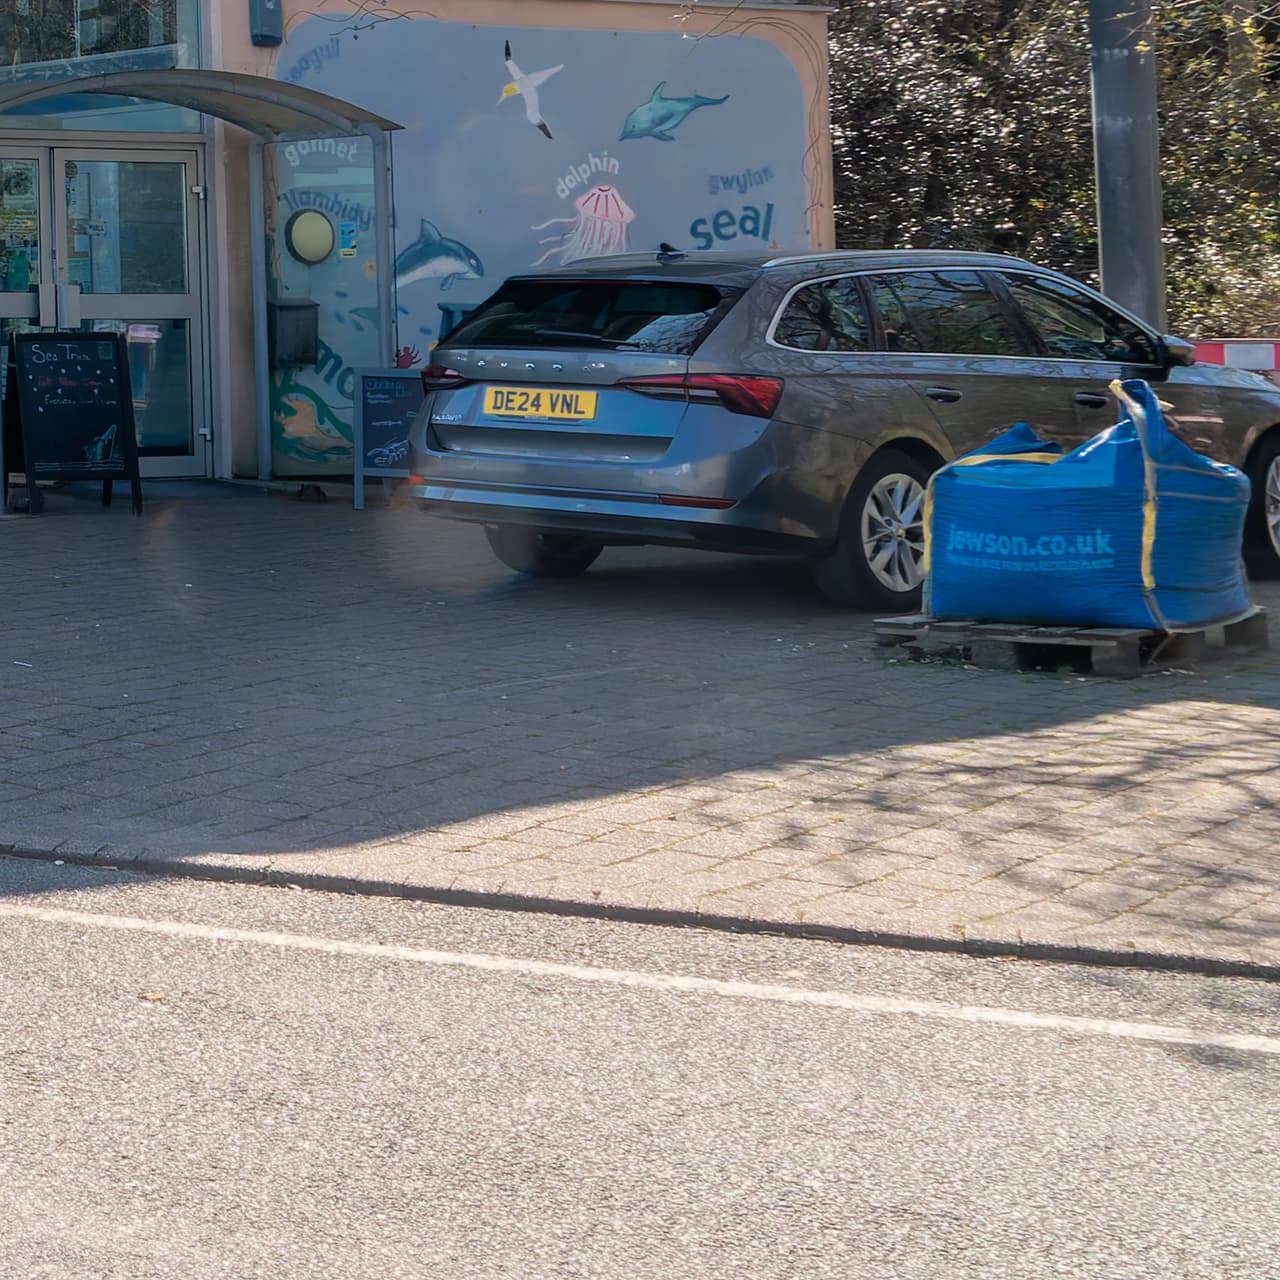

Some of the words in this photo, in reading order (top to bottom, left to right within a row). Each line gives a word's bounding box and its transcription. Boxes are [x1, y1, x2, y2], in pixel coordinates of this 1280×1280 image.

[555, 151, 620, 199] dolphin
[689, 202, 775, 250] seal
[492, 390, 542, 412] DE24
[549, 392, 586, 415] VNL
[945, 523, 1117, 556] jewson.co.uk
